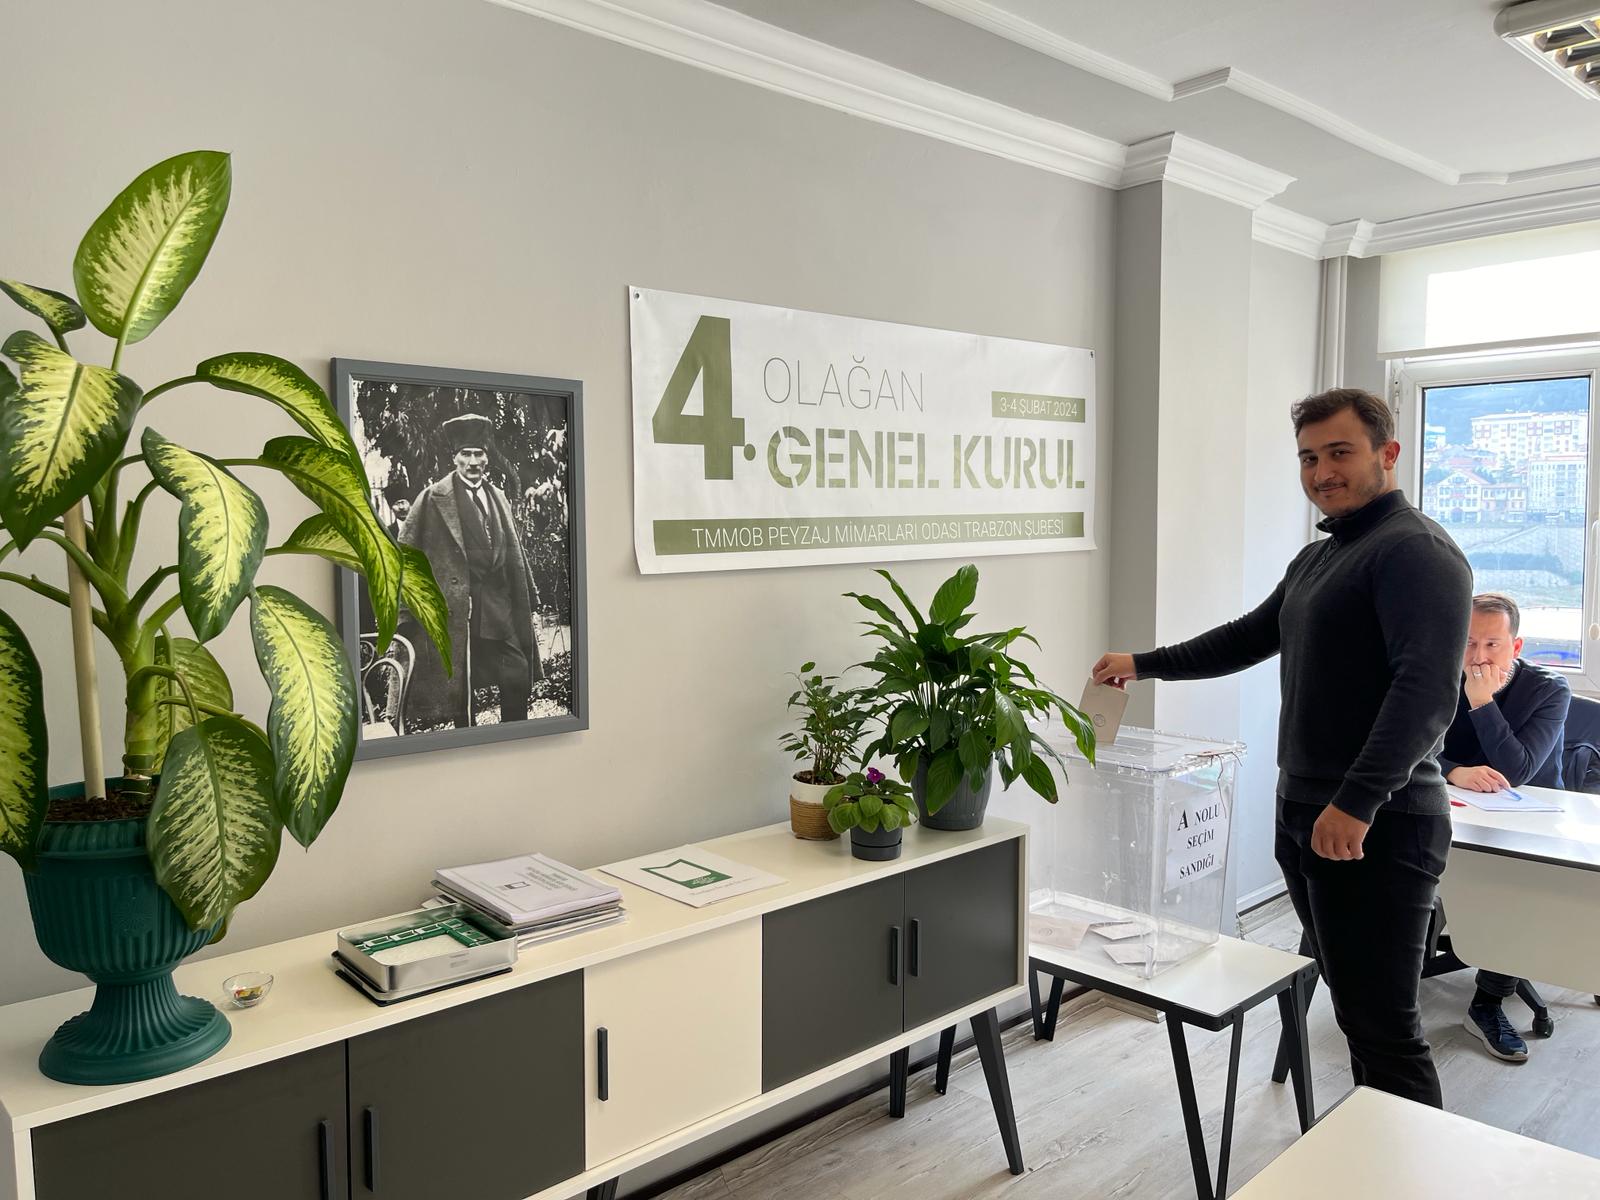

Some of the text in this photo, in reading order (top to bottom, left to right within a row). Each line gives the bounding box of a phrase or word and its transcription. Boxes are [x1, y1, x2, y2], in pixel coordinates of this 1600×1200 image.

[652, 314, 756, 481] 4.
[763, 354, 924, 413] OLAĞAN
[1000, 397, 1077, 416] 3-4 ŞUBAT 2024
[767, 426, 1086, 489] GENEL KURUL
[692, 517, 1064, 549] TMMOB PEYZAJ MİMARLARI ODASI TRABZON ŞUBESİ
[1177, 803, 1220, 831] A NOLU
[1186, 828, 1214, 849] SEÇİM
[1180, 853, 1214, 879] SANDIĞI
